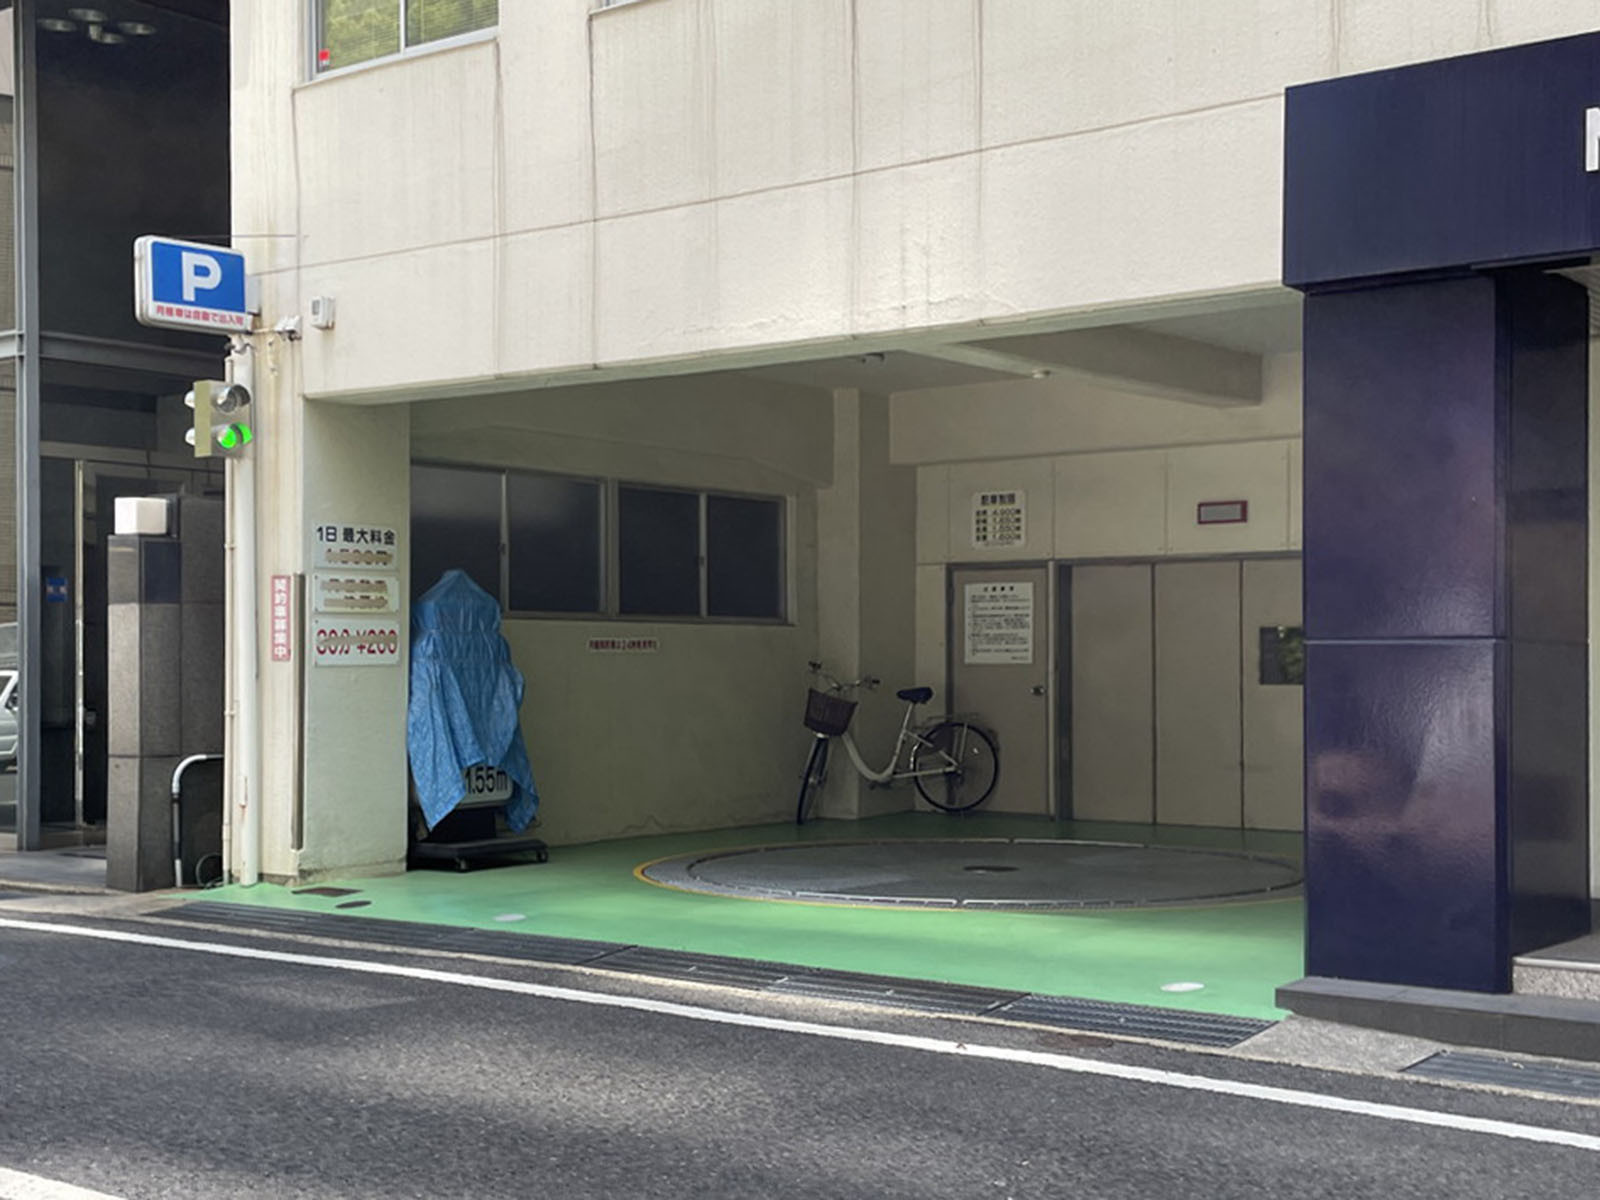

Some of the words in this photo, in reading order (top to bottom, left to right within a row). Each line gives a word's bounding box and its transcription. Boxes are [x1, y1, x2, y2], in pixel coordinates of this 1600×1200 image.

[181, 250, 222, 302] P
[316, 526, 337, 542] 1日
[342, 527, 395, 546] 最大料金
[464, 766, 508, 795] 1.55m
